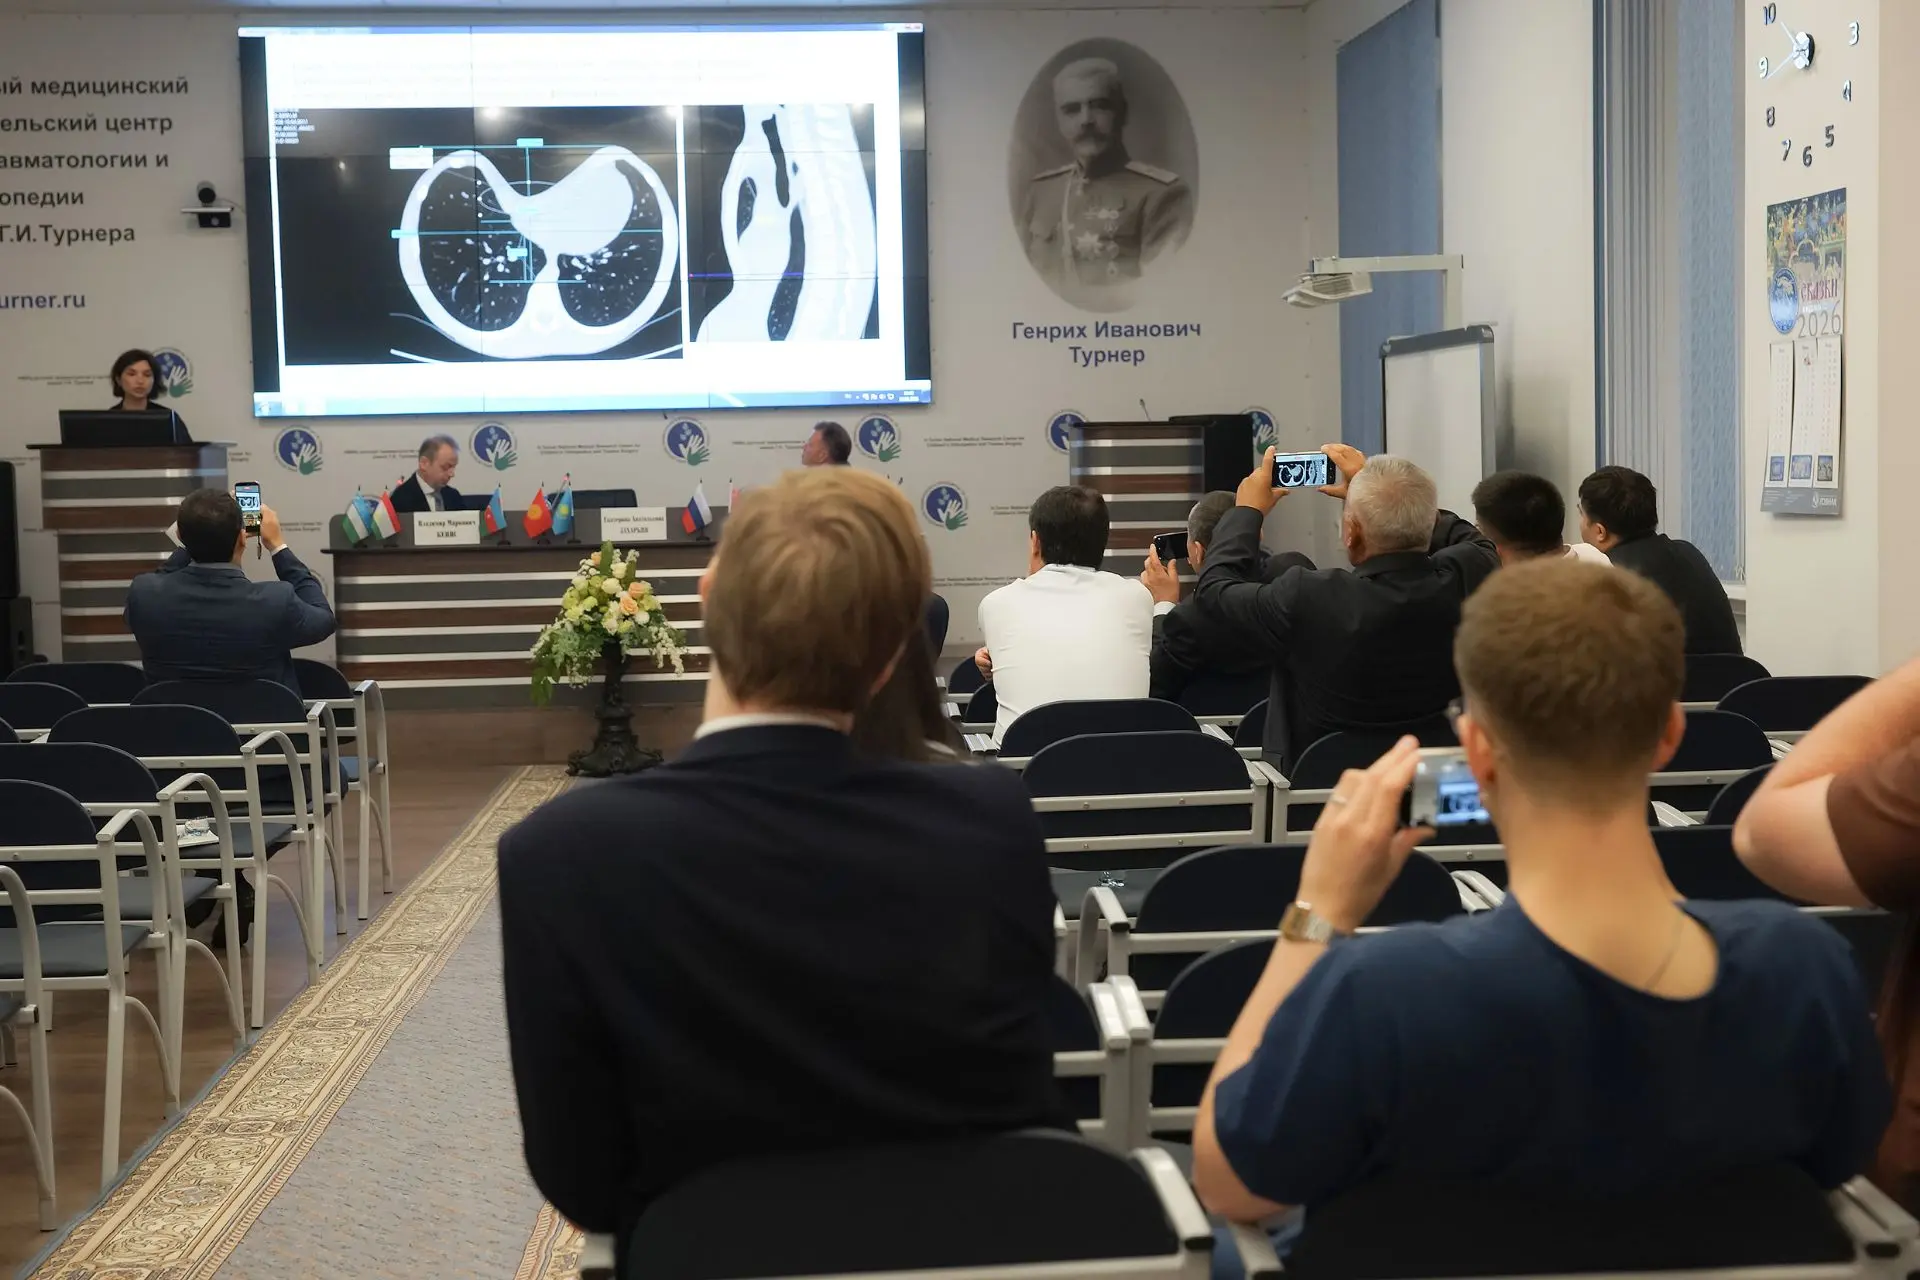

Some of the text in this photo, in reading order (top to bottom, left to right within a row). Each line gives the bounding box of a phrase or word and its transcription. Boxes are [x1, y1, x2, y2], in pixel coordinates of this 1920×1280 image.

[1763, 2, 1777, 25] 10
[1848, 21, 1859, 46] 3
[1758, 56, 1769, 79] 9
[31, 77, 189, 97] медицинский
[1842, 80, 1852, 102] 4
[1, 113, 173, 135] ельский центр
[1766, 106, 1776, 127] 8
[1825, 124, 1835, 148] 5
[0, 153, 169, 169] авматологии и
[1782, 139, 1792, 161] 7
[1802, 146, 1813, 167] 6
[0, 191, 84, 207] опедии
[0, 293, 86, 310] urner.ru
[1798, 300, 1841, 338] 2026
[1012, 321, 1201, 343] Генрих Иванович
[1069, 346, 1145, 367] Турнер
